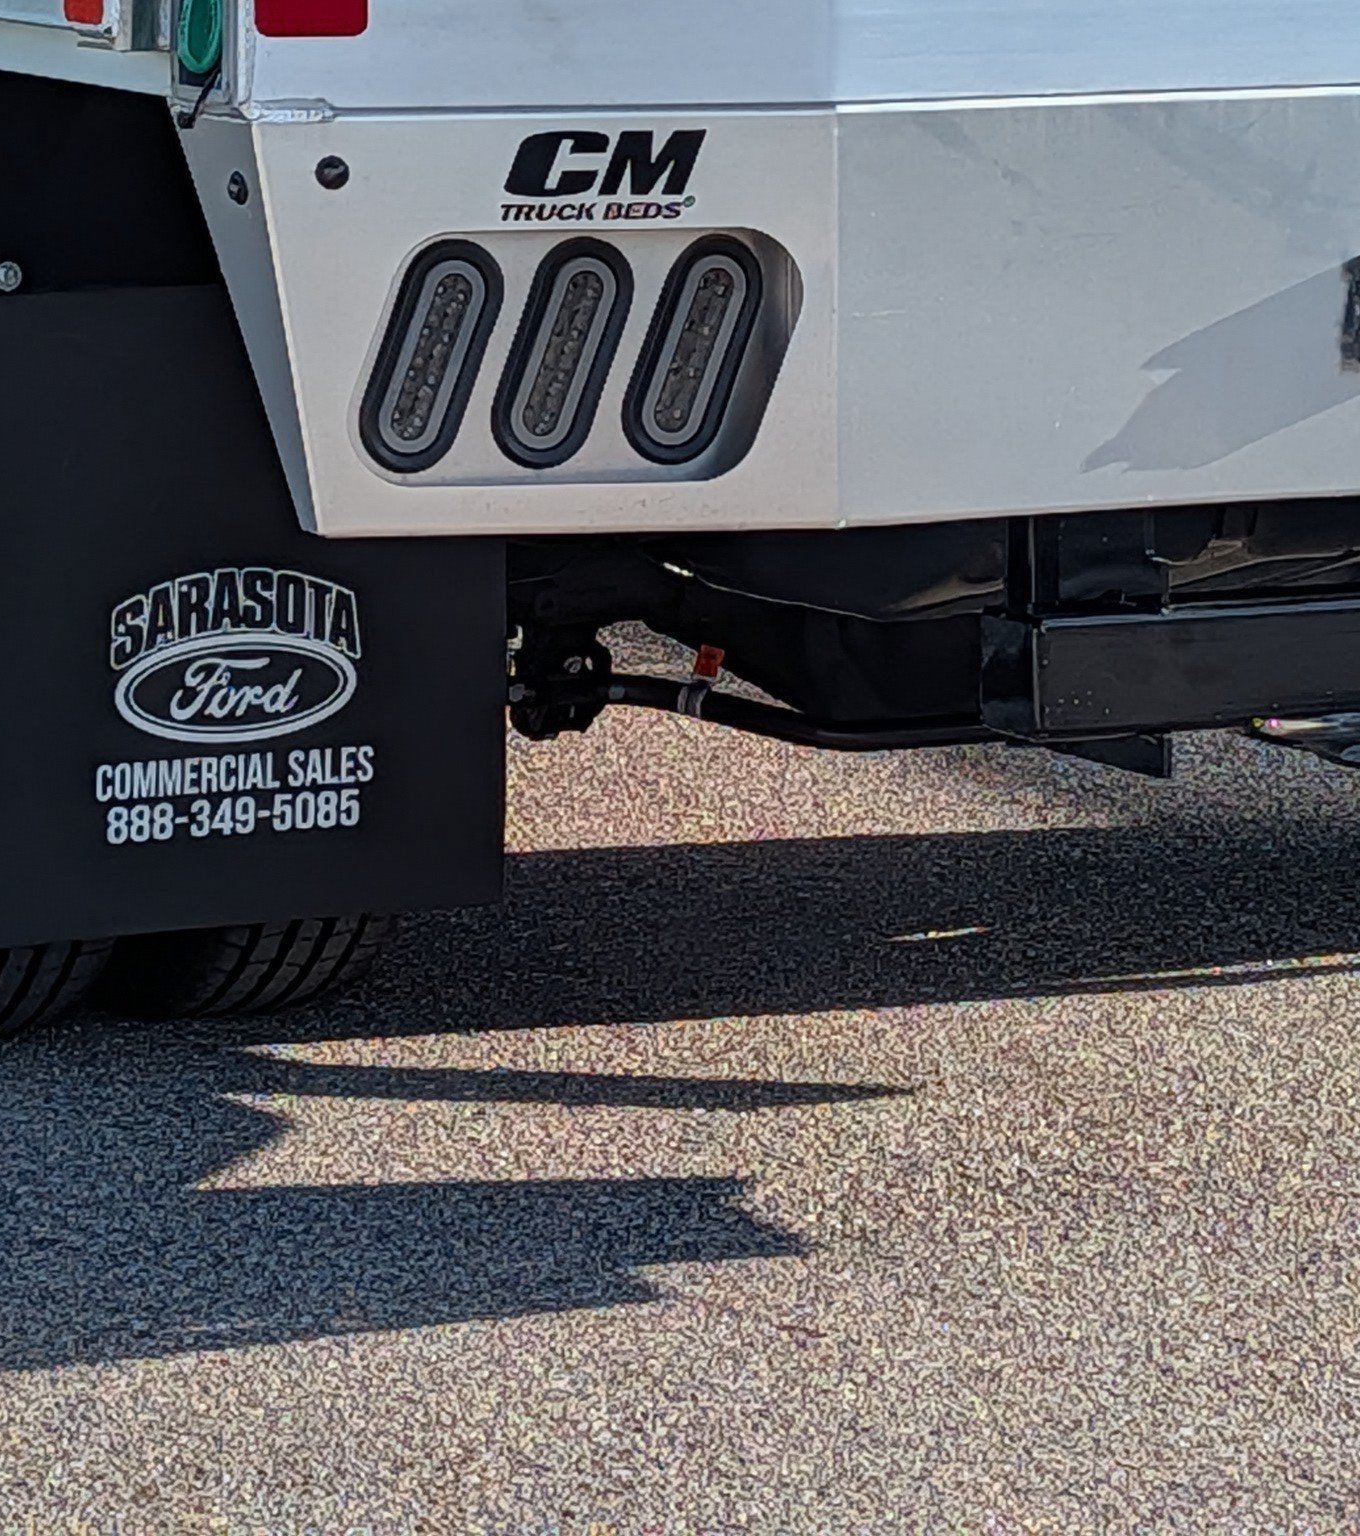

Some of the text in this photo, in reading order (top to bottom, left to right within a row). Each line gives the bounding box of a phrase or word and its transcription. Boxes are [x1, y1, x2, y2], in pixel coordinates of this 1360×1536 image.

[504, 129, 707, 197] CM
[500, 201, 683, 221] TRUCK BEDS
[110, 567, 362, 670] SARASOTA
[169, 656, 303, 720] Ford
[95, 745, 375, 802] COMMERCIAL SALES
[106, 788, 361, 845] 888-349-5085
